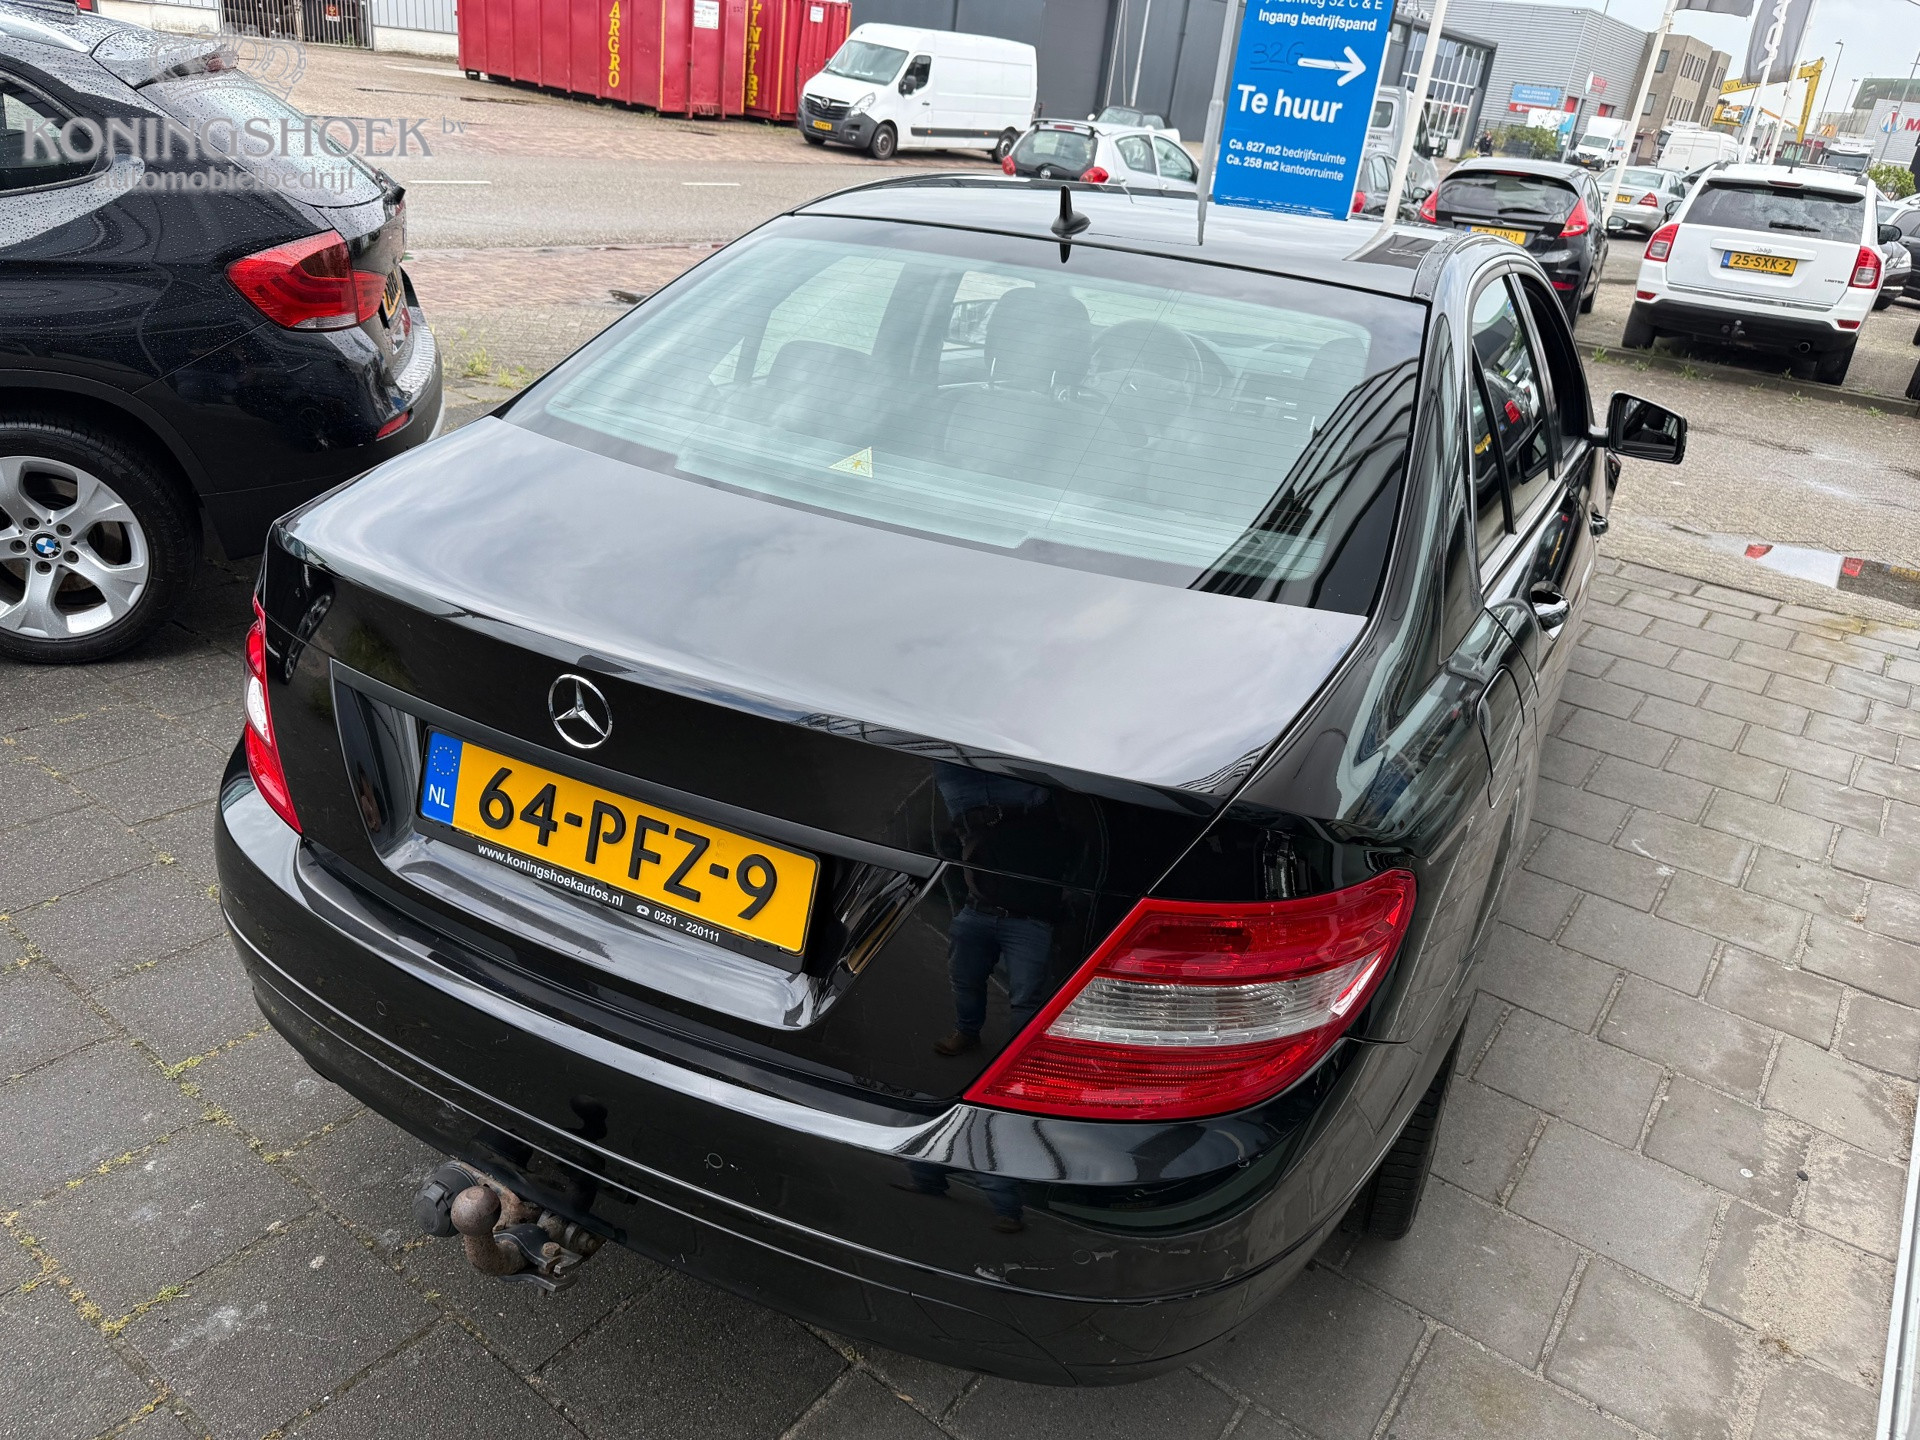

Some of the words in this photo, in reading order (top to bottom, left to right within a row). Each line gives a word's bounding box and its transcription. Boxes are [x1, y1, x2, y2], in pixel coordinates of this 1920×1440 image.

[1258, 9, 1298, 27] Ingang
[1300, 13, 1378, 32] bedrijfspand
[1237, 84, 1268, 115] Te
[1273, 88, 1343, 124] huur
[1229, 138, 1244, 151] Ca.
[1246, 141, 1266, 152] 827
[1265, 144, 1281, 155] m2
[1282, 146, 1347, 166] bedrijfsruimte
[1226, 154, 1242, 166] Ca.
[1243, 157, 1262, 169] 258
[1263, 160, 1279, 171] m2
[1280, 162, 1344, 181] kantoorruimte
[1733, 253, 1792, 272] 25-SXK-2
[428, 782, 450, 809] NL
[478, 767, 778, 921] 64-PFZ-9
[477, 842, 624, 907] www.koningshoekautos.nl
[654, 909, 678, 927] 0251
[686, 922, 720, 944] 220111
